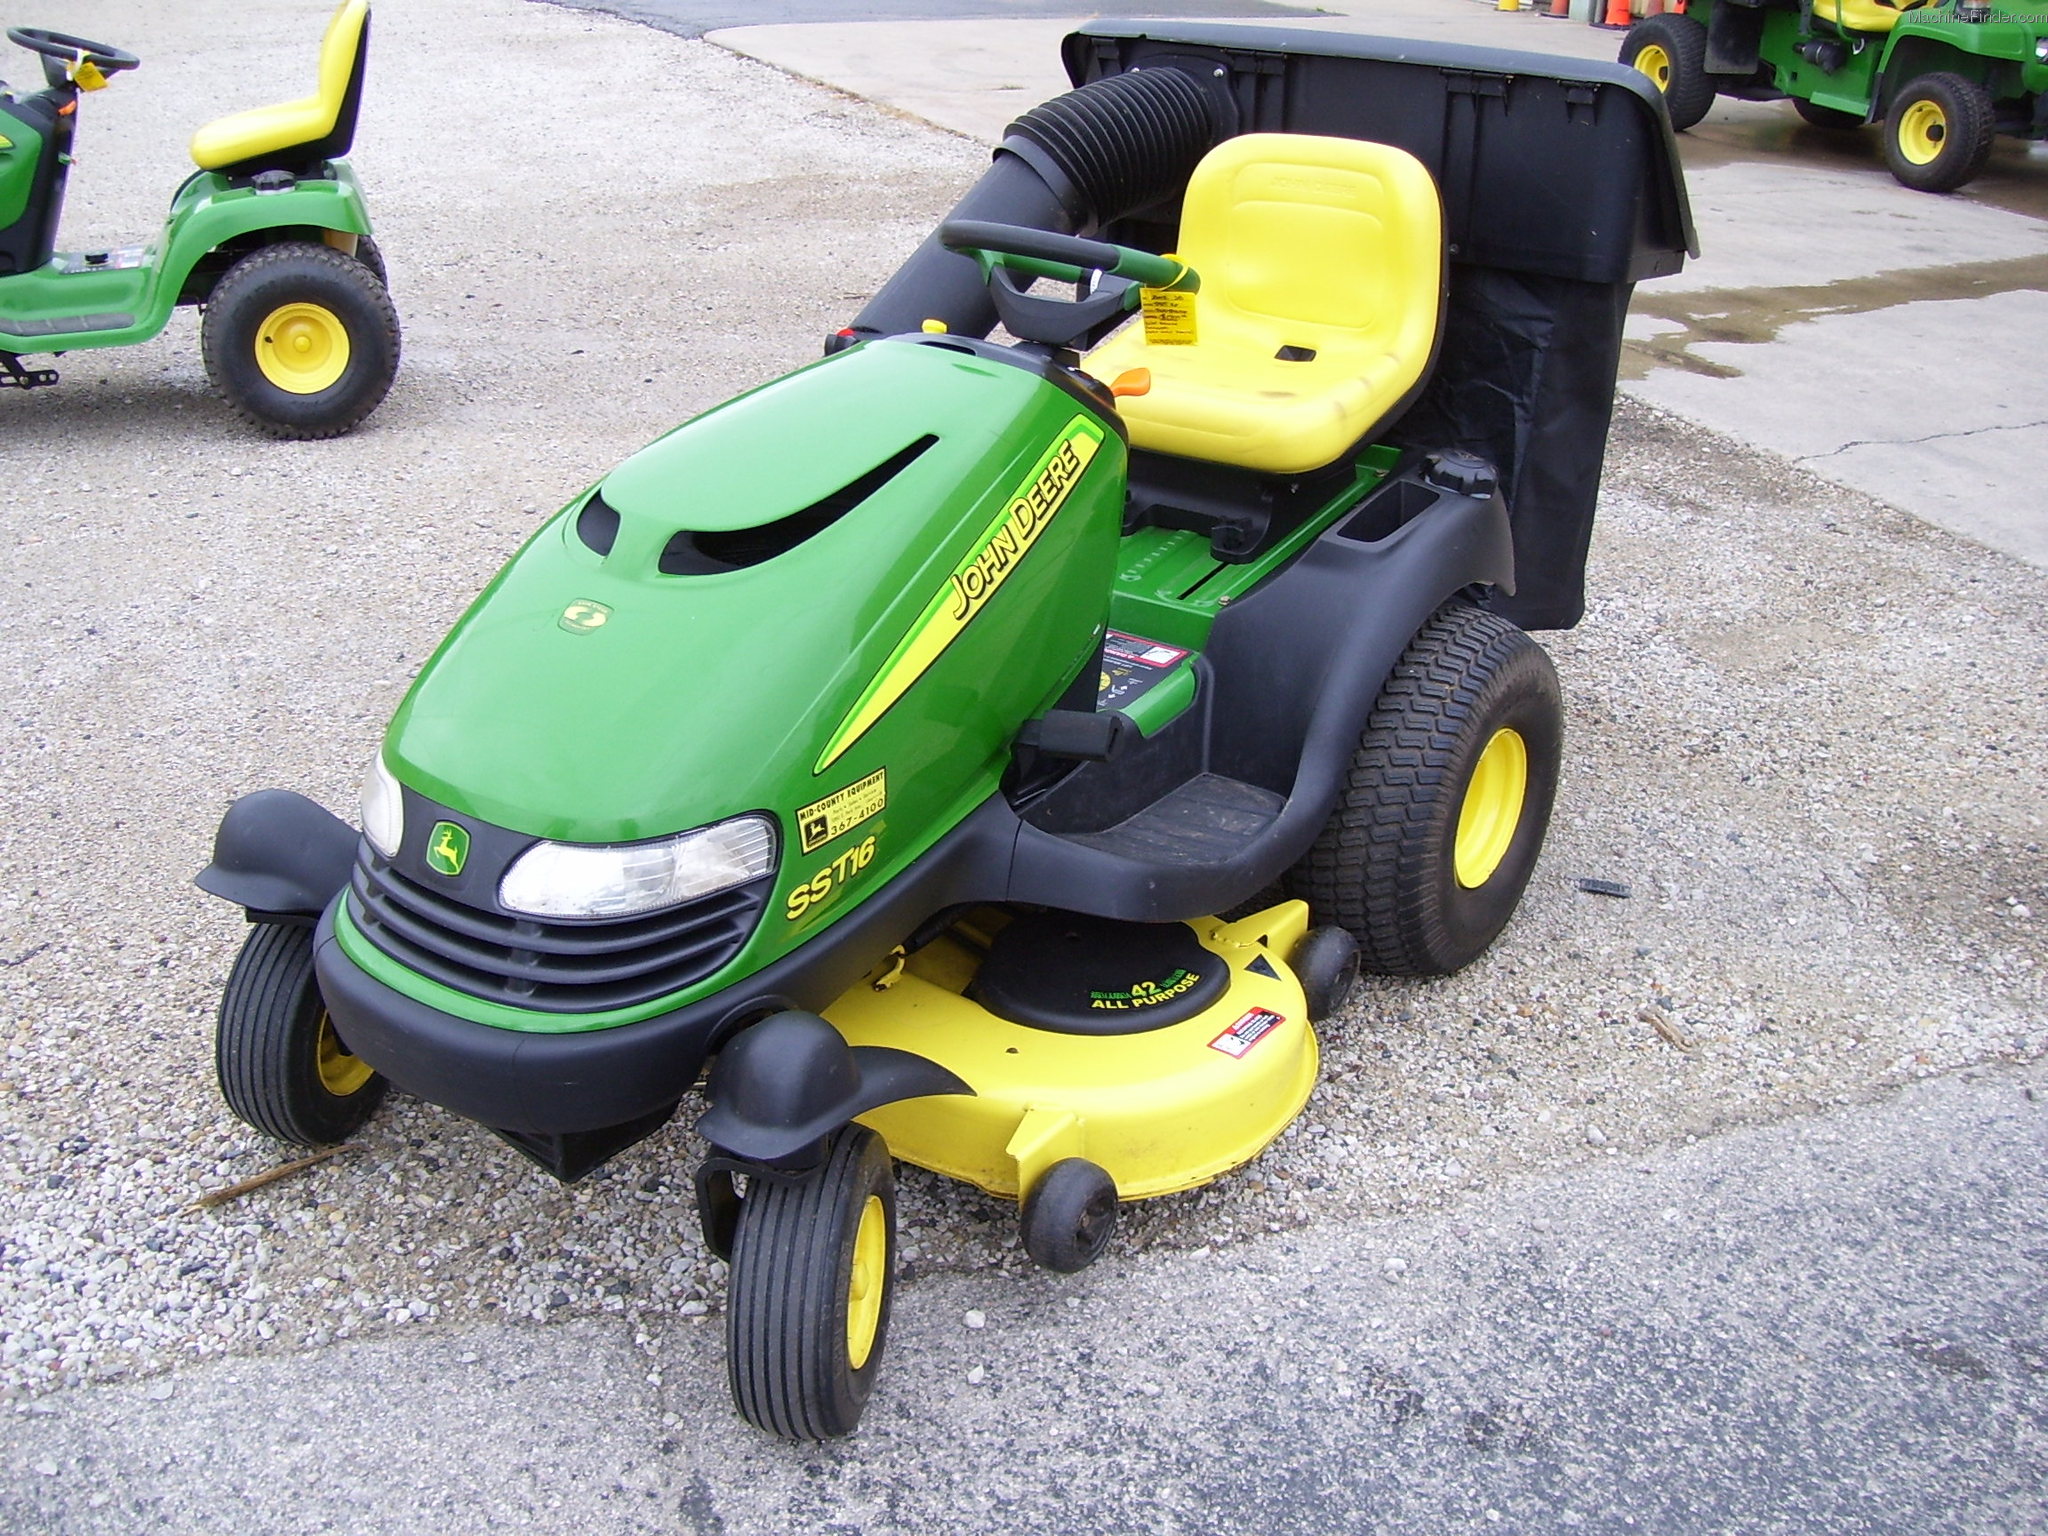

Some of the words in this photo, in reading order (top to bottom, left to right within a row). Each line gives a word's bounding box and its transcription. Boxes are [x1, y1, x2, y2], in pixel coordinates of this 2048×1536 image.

[950, 524, 1018, 620] JOHN
[1008, 439, 1080, 540] DEERE
[799, 793, 845, 821] MID-COUNTY
[847, 773, 884, 798] EQUIPMENT
[831, 798, 883, 835] 367-4100
[786, 835, 876, 920] SST16
[1091, 999, 1129, 1009] ALL
[1131, 972, 1200, 1008] PURPOSE
[1131, 981, 1161, 997] 42
